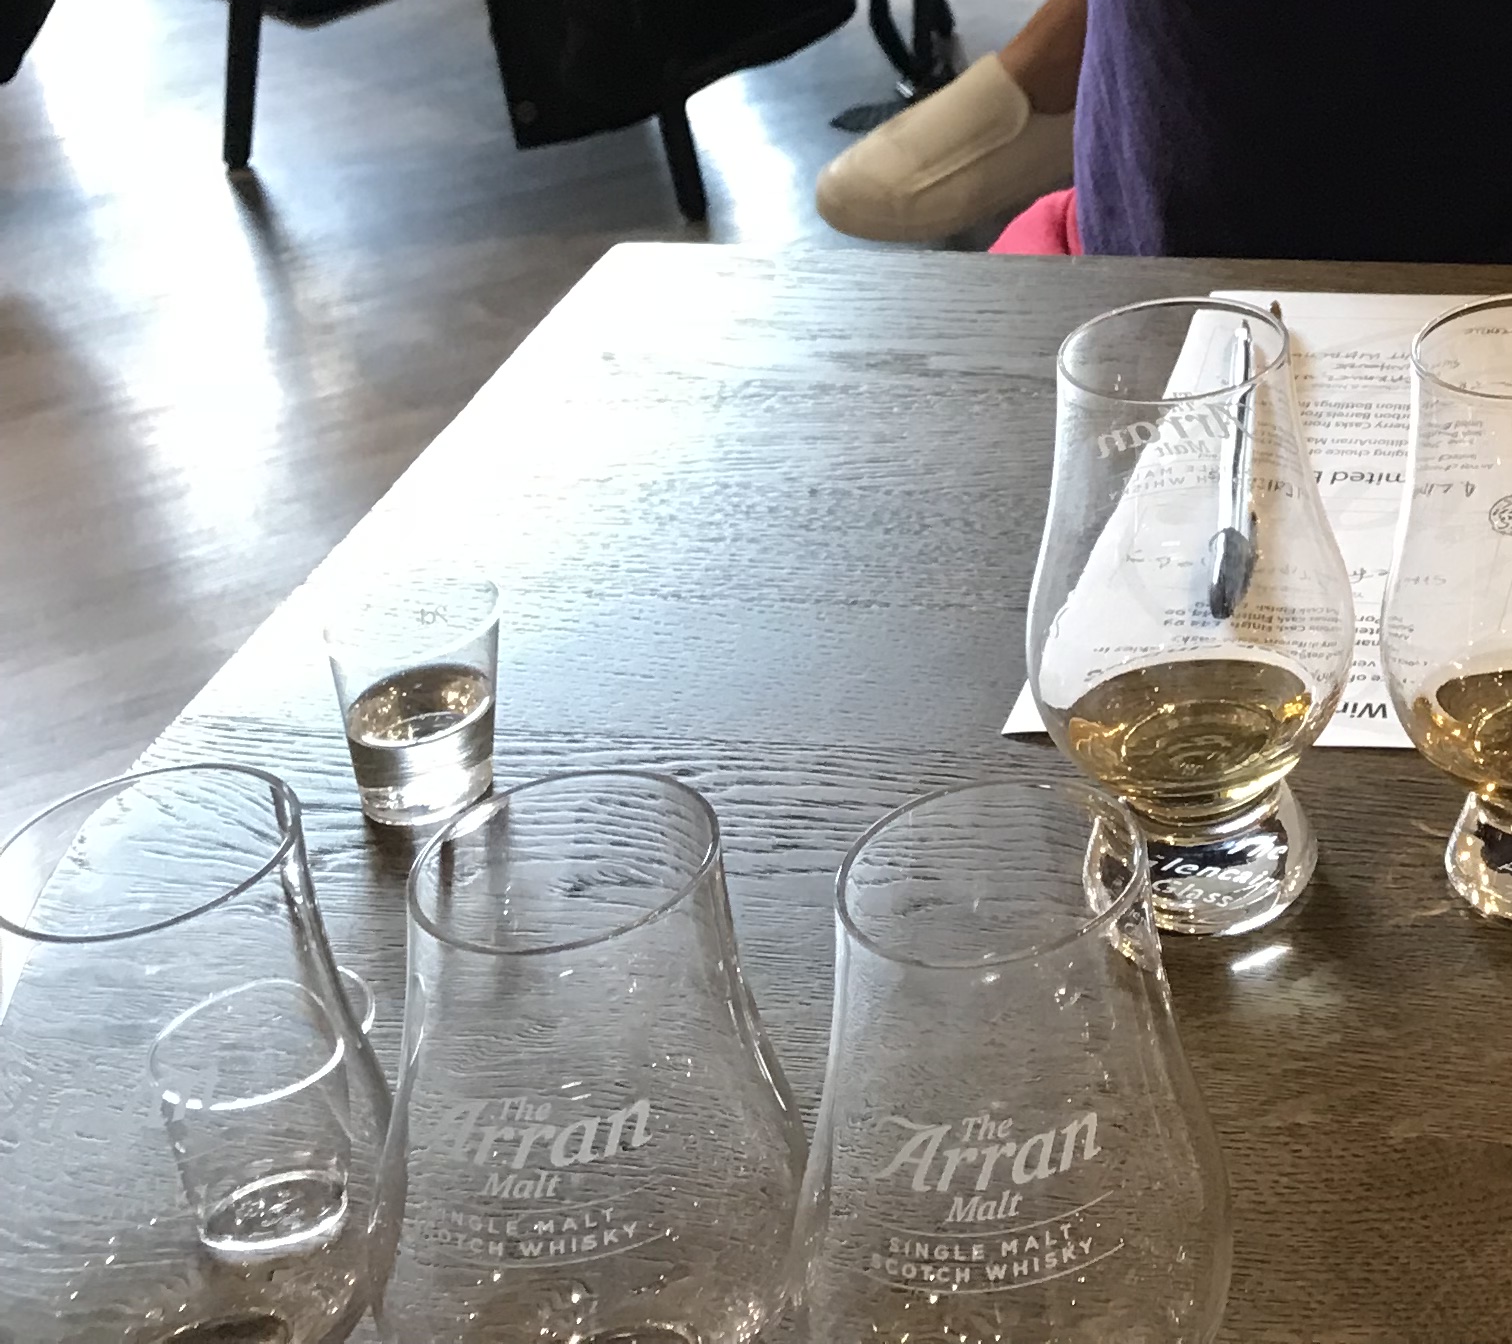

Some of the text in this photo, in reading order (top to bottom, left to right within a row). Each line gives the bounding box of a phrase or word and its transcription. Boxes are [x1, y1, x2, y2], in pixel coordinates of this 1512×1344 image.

[1326, 411, 1371, 420] Barrels
[1325, 449, 1370, 457] choice
[1152, 879, 1233, 907] Glass
[500, 1096, 549, 1121] The
[962, 1114, 1014, 1142] The
[873, 1112, 1101, 1192] Arran
[482, 1169, 561, 1199] Malt
[945, 1190, 1024, 1223] Malt
[536, 1208, 615, 1236] MALT
[519, 1222, 639, 1258] WHISKY
[889, 1223, 1072, 1262] SINGLE MALT
[871, 1236, 1093, 1284] SCOTCH WHISKY
